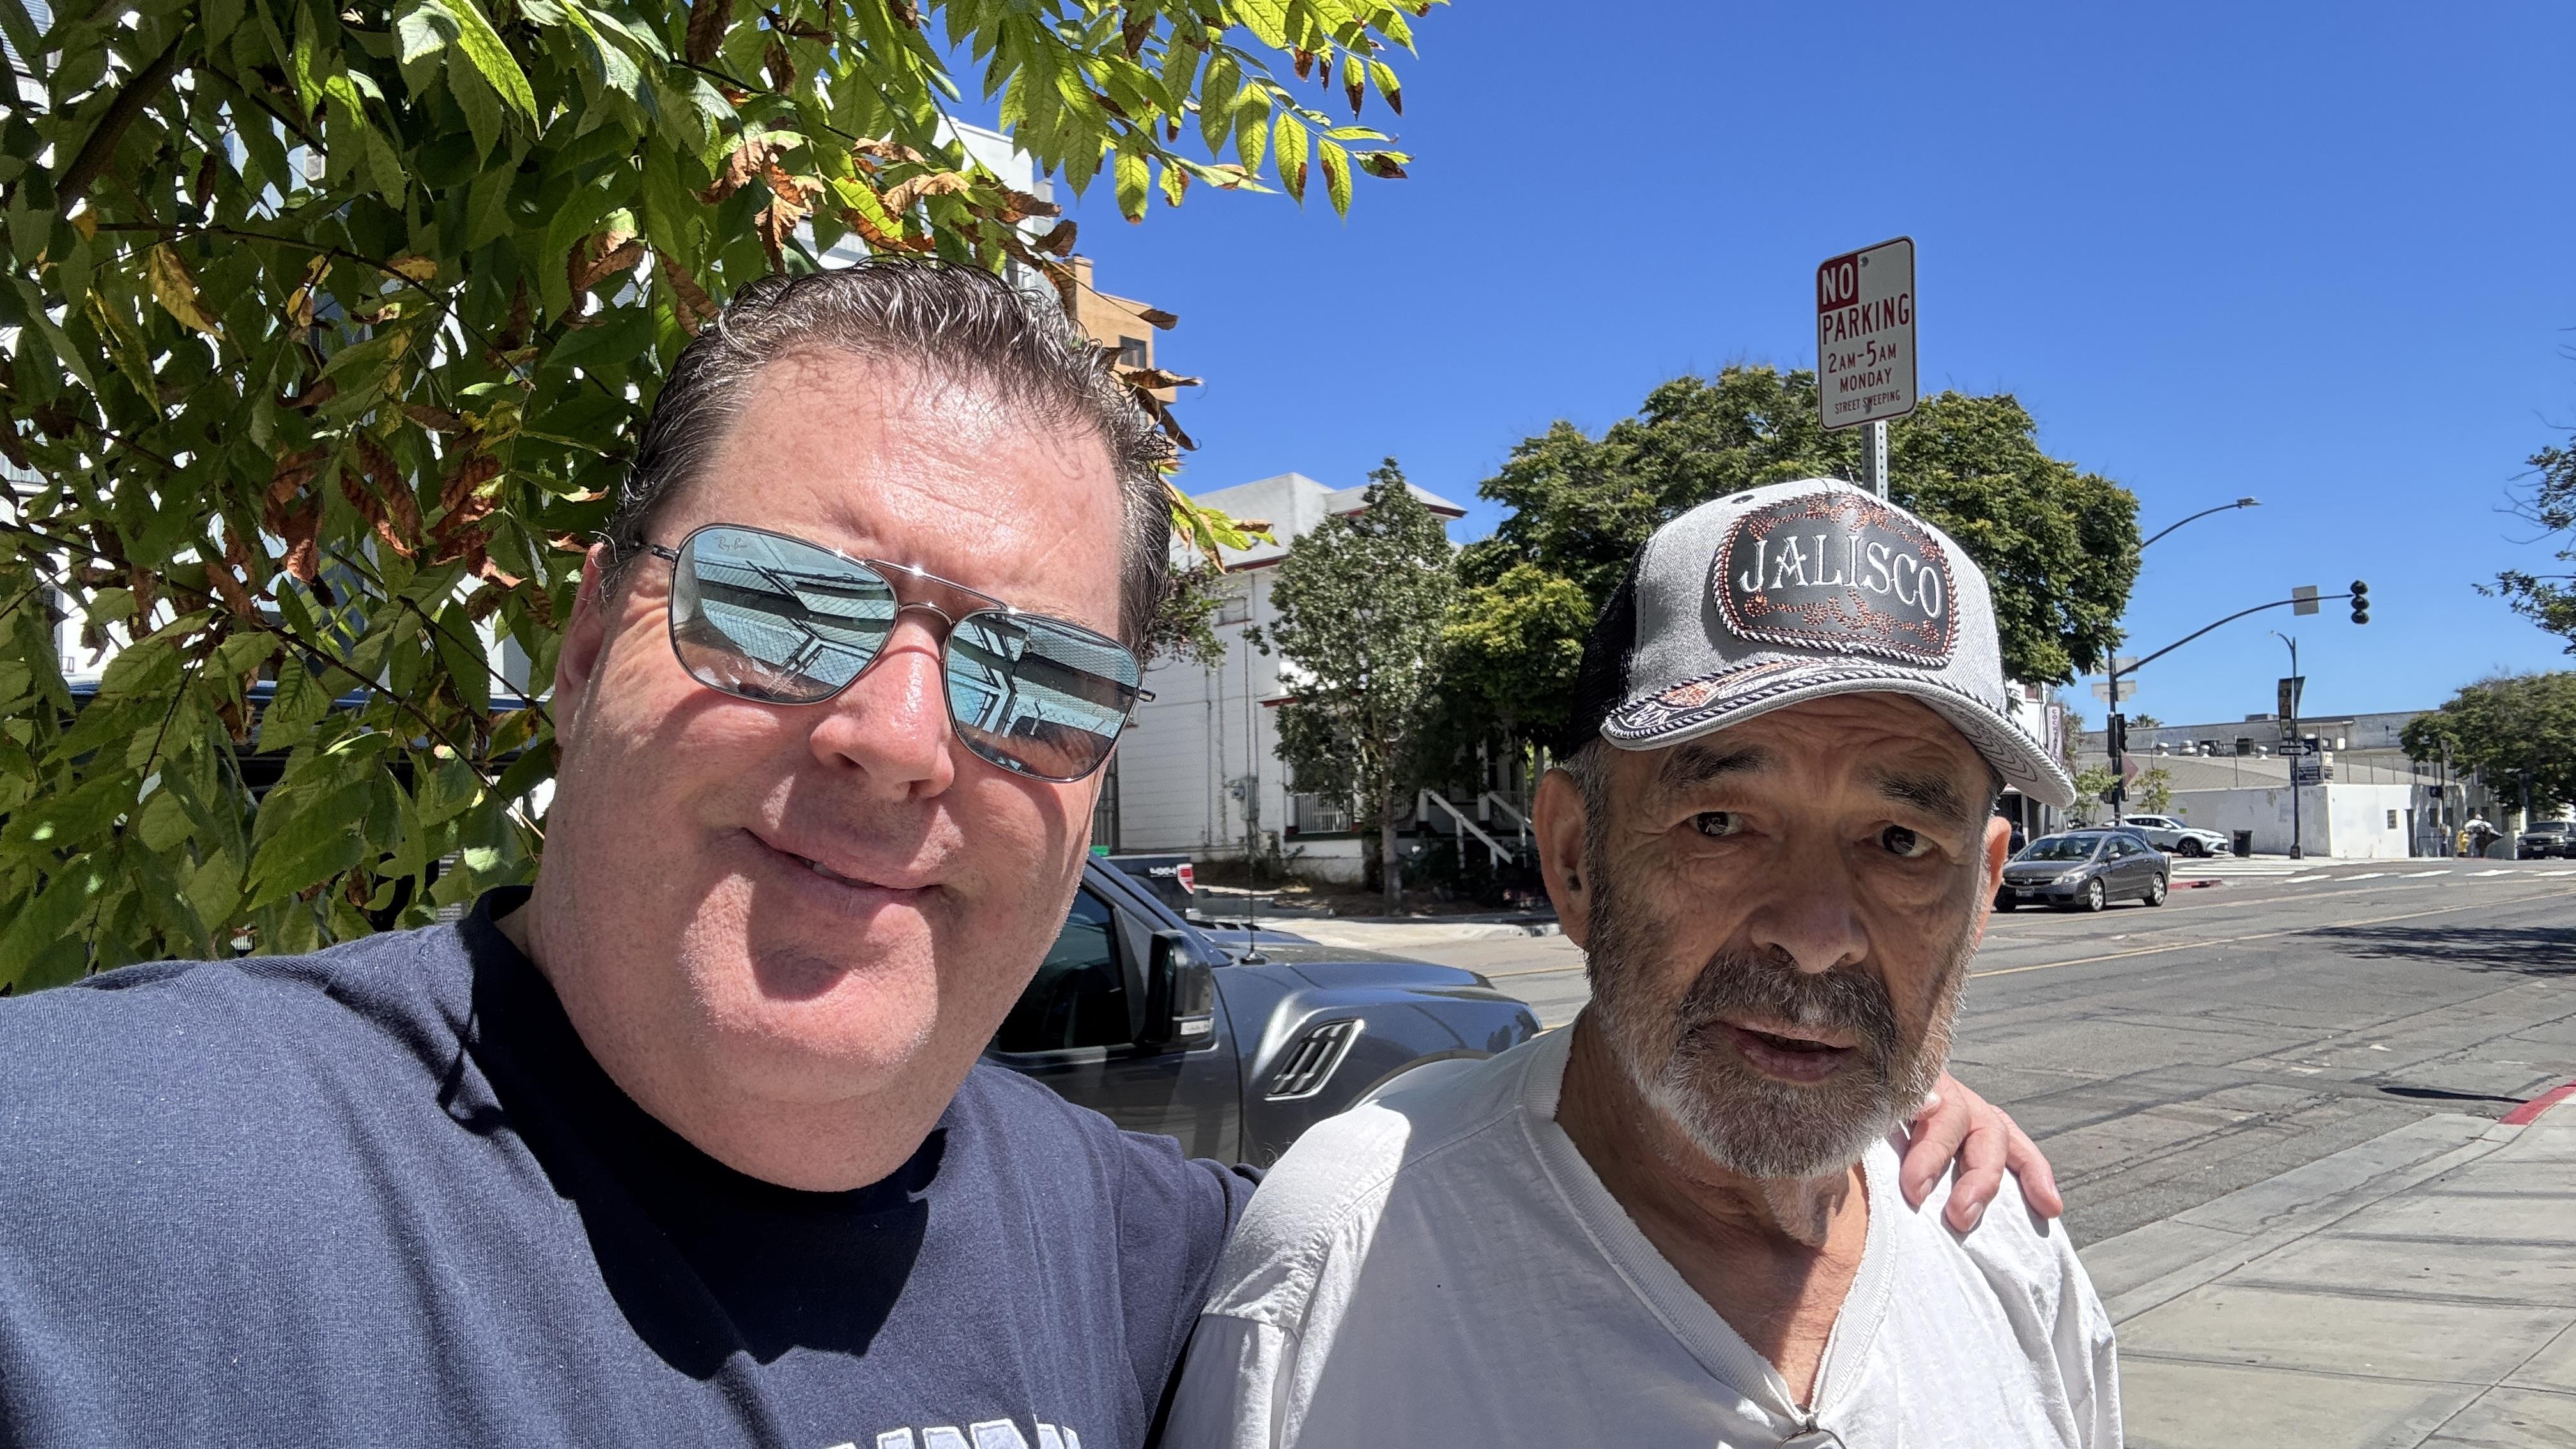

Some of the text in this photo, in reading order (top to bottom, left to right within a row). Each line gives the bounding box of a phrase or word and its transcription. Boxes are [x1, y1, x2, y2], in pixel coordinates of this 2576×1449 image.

[1822, 262, 1853, 305] NO
[1823, 293, 1910, 345] PARKING
[1828, 340, 1897, 374] 2AM-5AM
[1839, 367, 1892, 394] MONDAY
[1834, 389, 1901, 415] STREET SWEEPING
[1738, 534, 1942, 618] JALISCO
